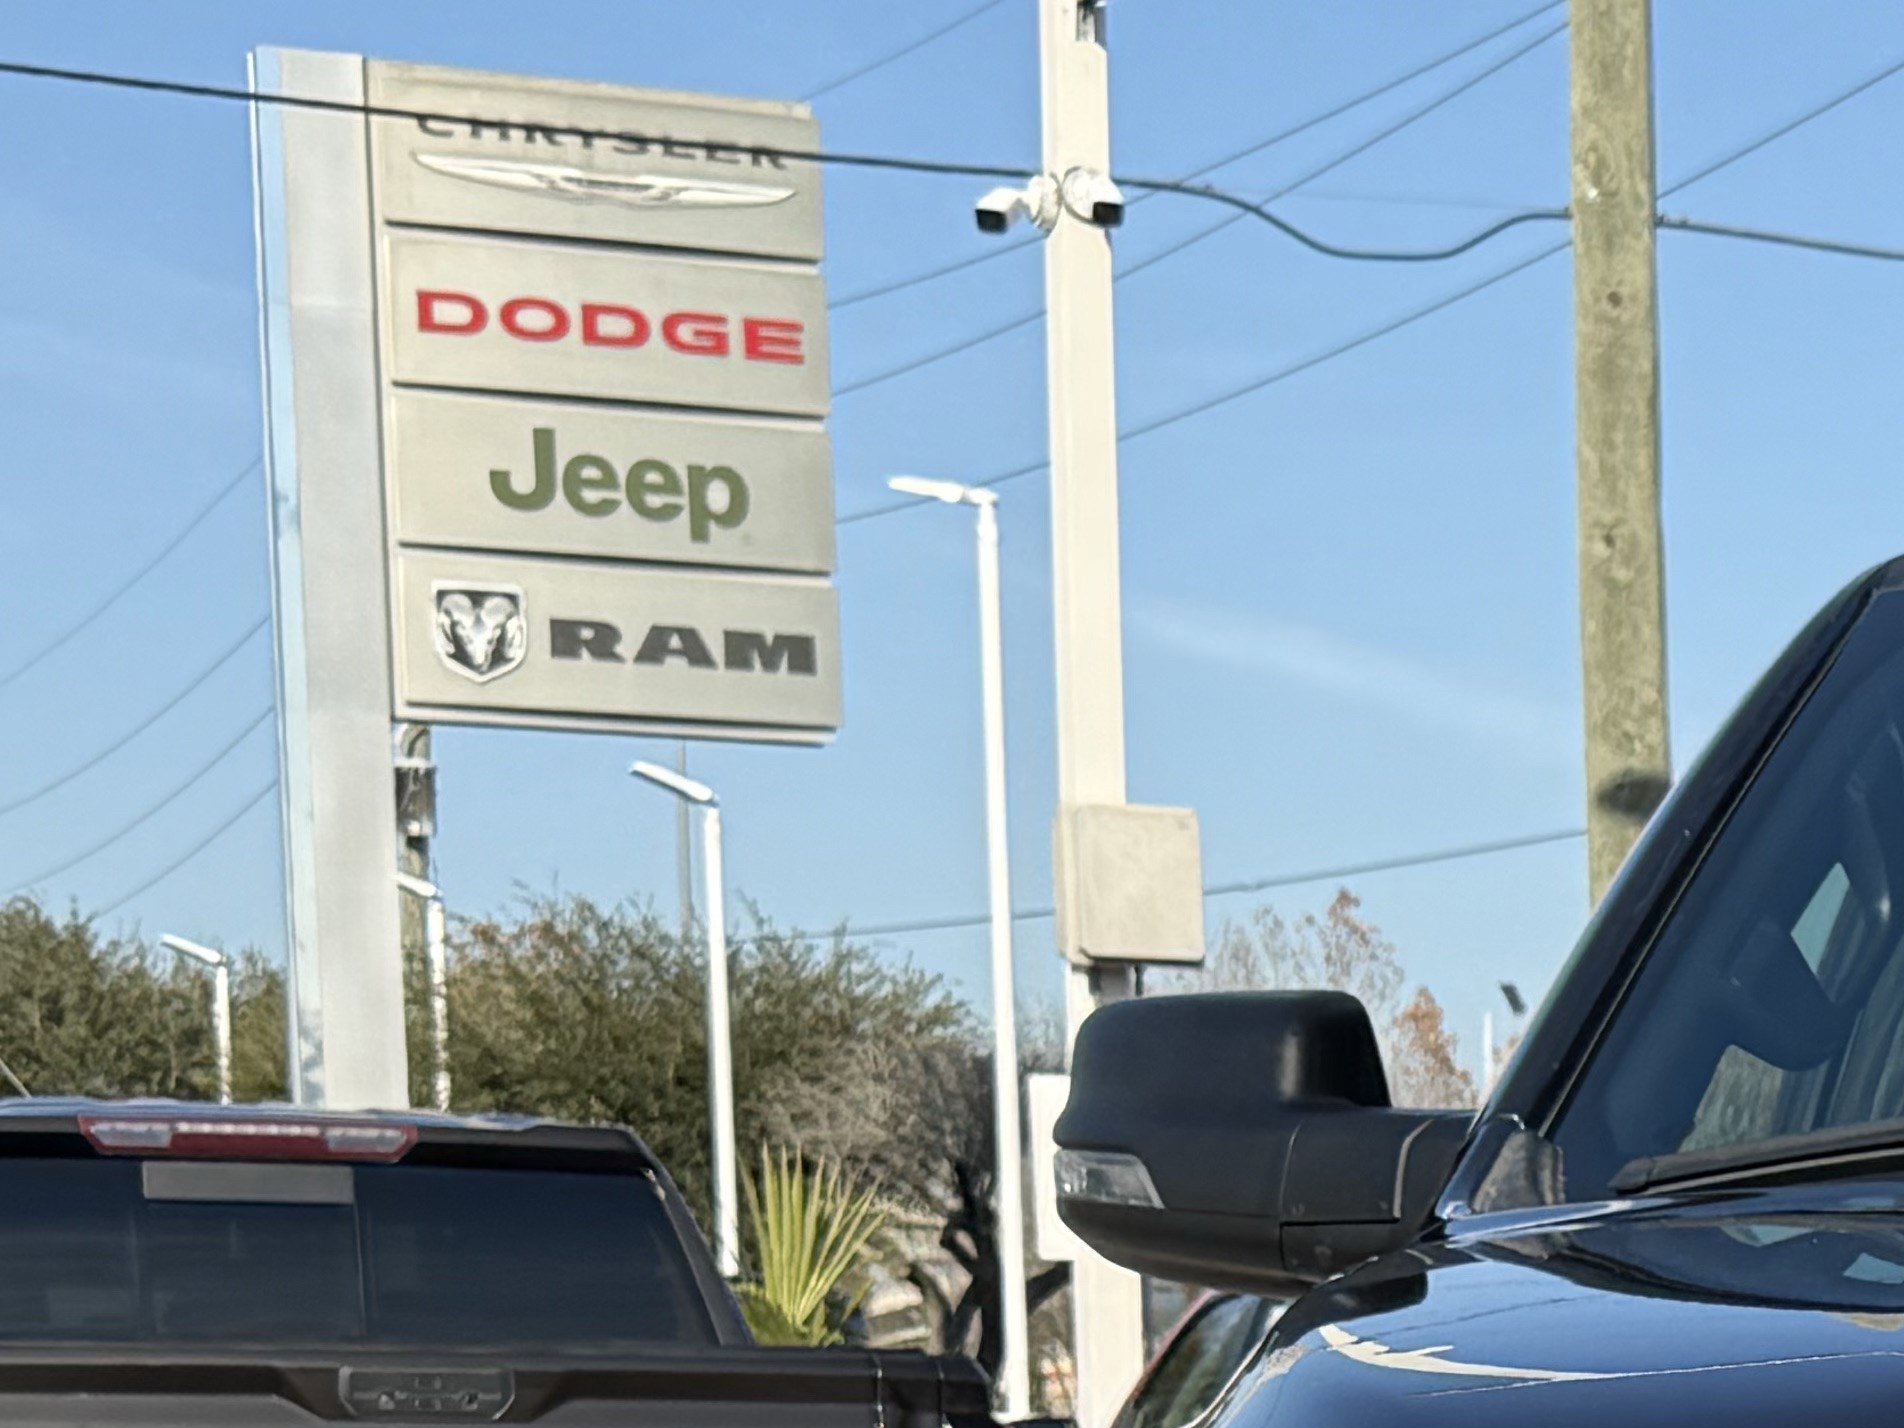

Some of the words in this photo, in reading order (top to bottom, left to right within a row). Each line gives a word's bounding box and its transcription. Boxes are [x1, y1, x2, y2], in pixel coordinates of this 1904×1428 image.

[416, 289, 806, 364] DODGE
[489, 427, 751, 542] Jeep
[549, 617, 818, 676] RAM
